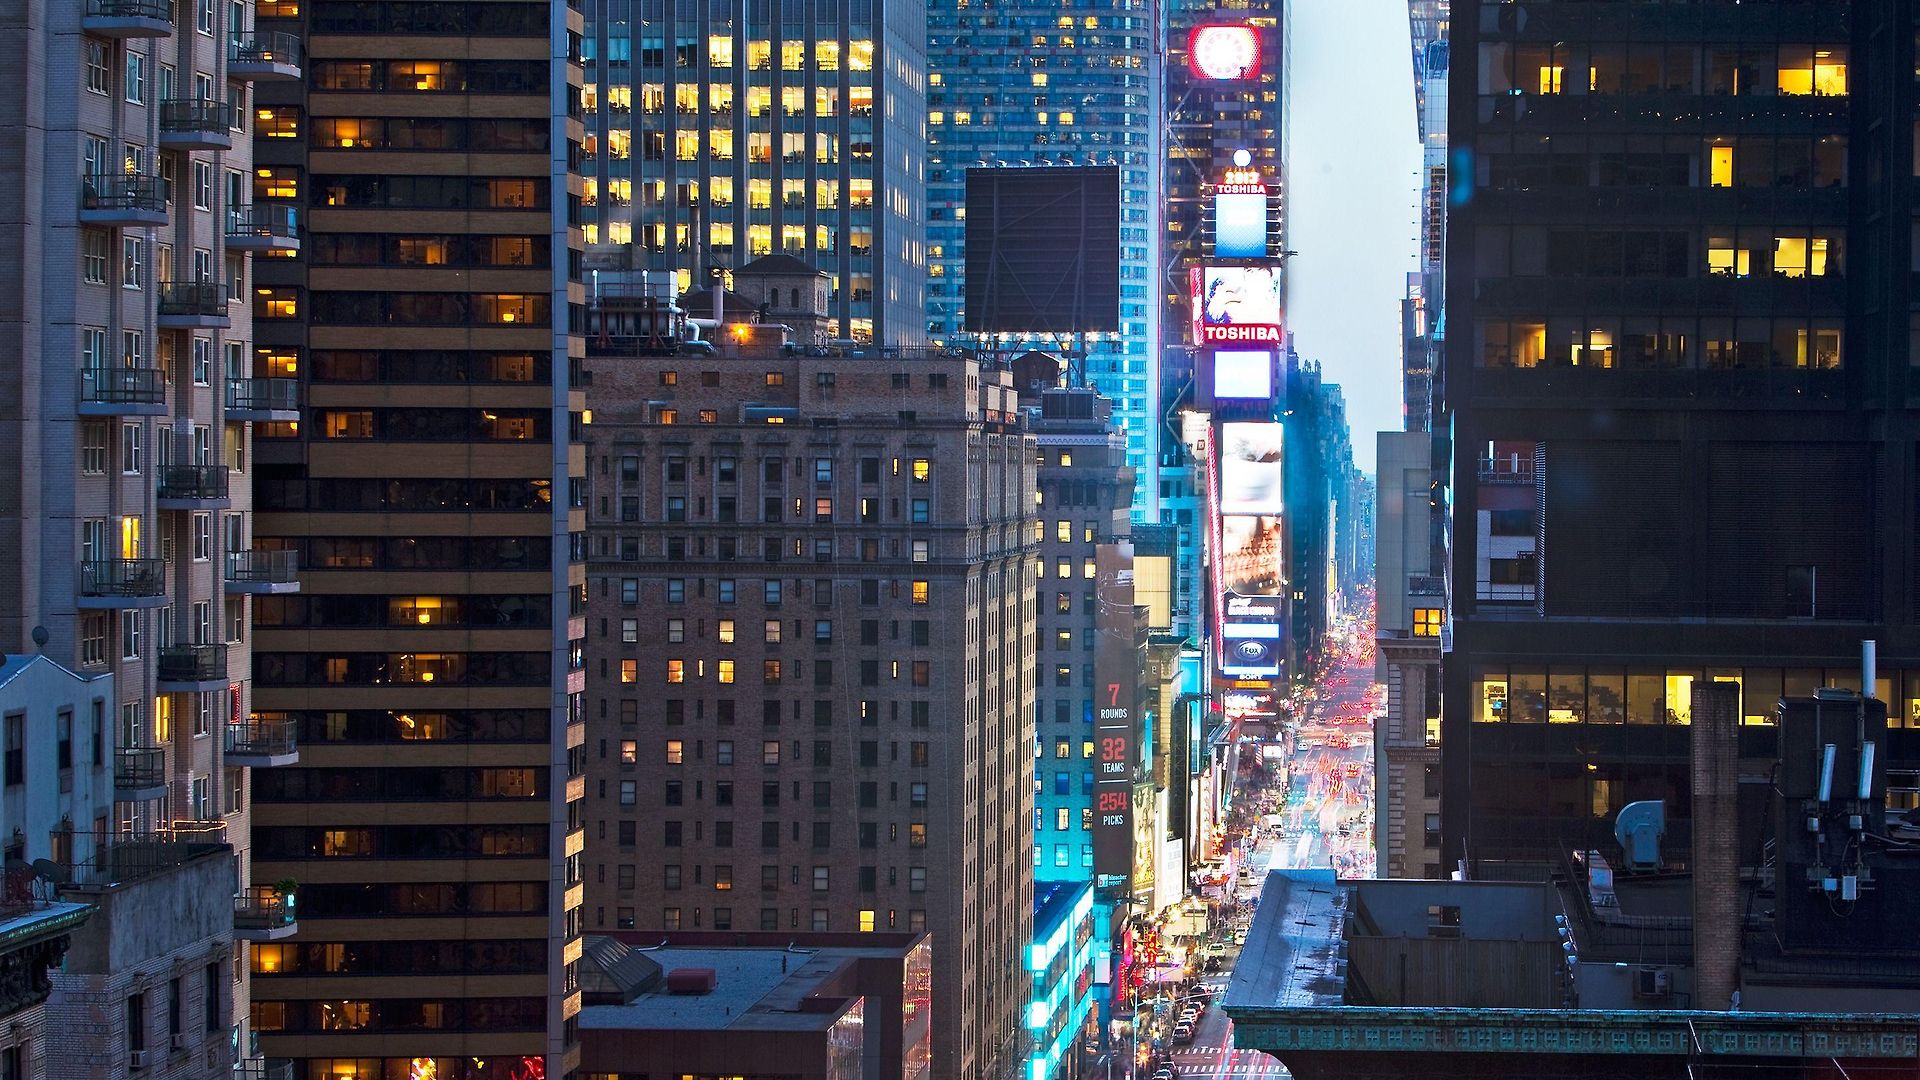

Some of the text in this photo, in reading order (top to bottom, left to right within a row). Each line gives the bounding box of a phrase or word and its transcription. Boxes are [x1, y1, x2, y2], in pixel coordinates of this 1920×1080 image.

[1217, 185, 1266, 193] TOSHIBA
[1205, 327, 1280, 340] TOSHIBA
[1108, 683, 1120, 706] 7
[1100, 708, 1128, 719] ROUNDS
[1102, 737, 1126, 760] 32
[1102, 763, 1125, 773] TEAMS
[1099, 792, 1127, 811] 254
[1103, 815, 1124, 825] PICKS
